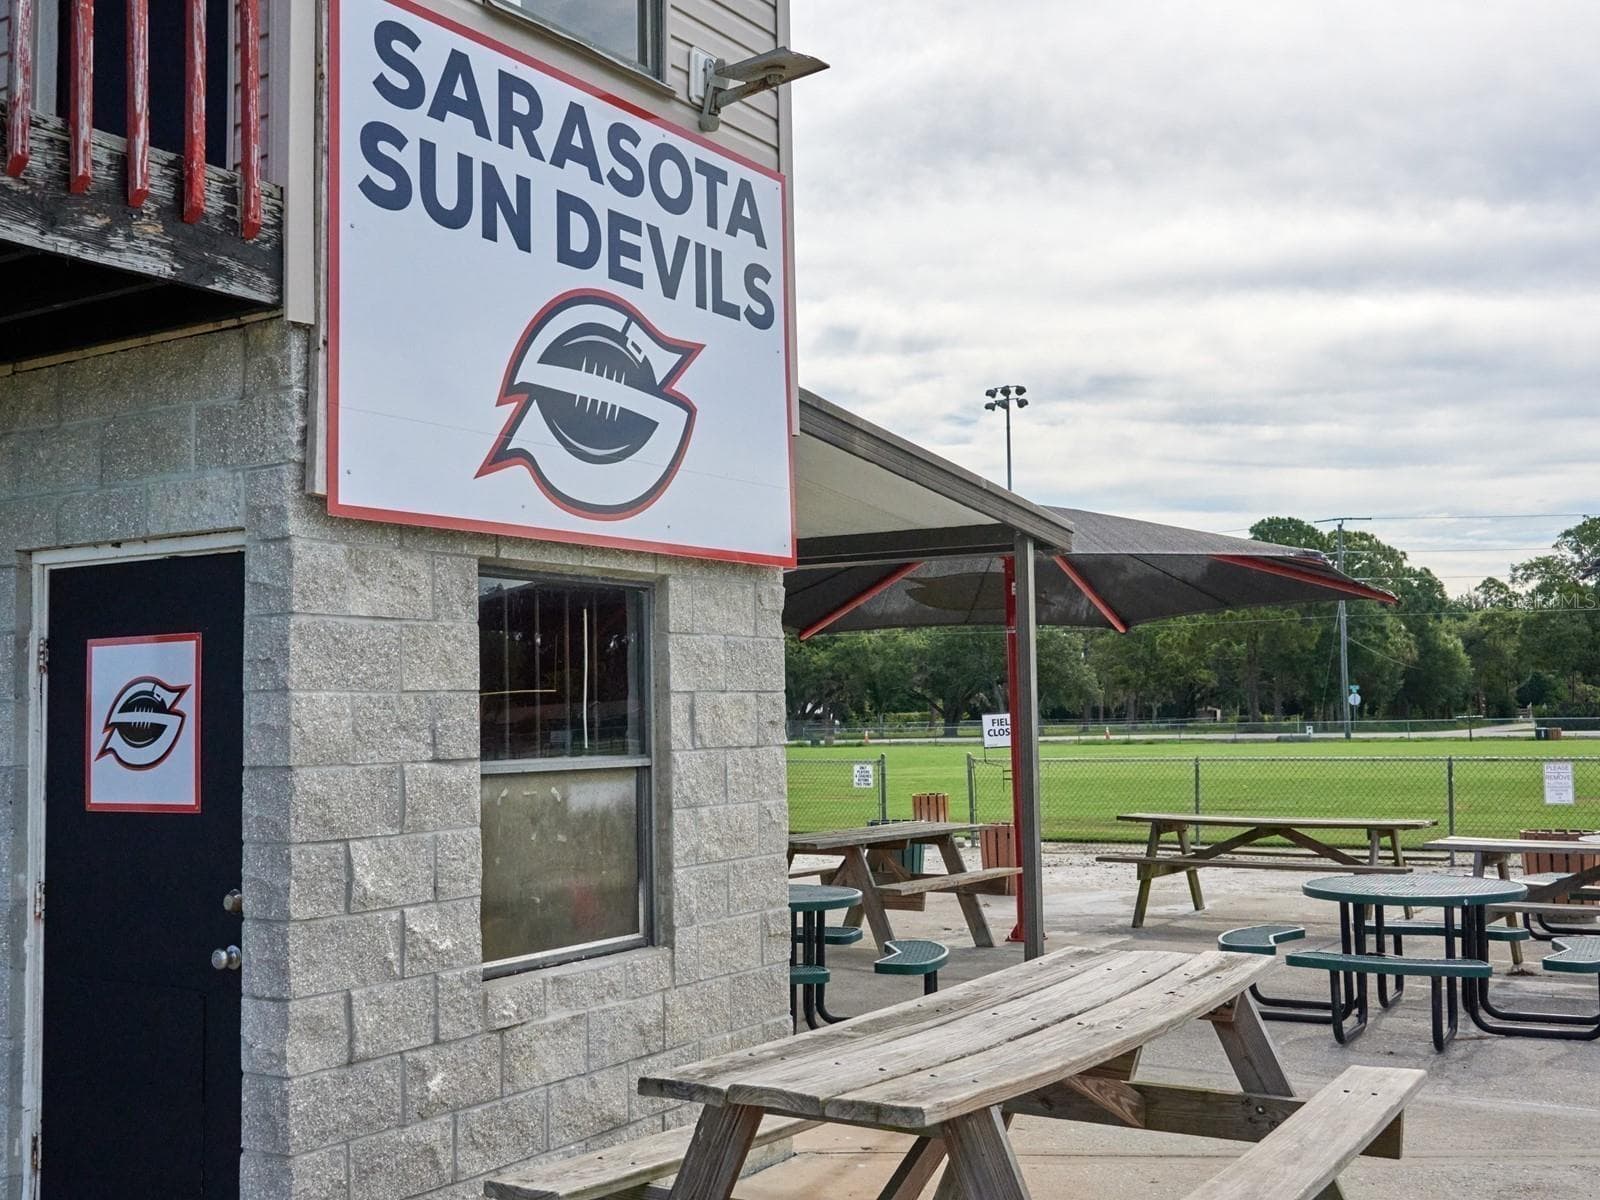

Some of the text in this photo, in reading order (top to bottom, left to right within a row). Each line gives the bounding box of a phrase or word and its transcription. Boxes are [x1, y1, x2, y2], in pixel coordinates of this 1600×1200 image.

[372, 20, 767, 250] SARASOTA
[357, 120, 775, 331] SUN DEVILS
[987, 728, 1011, 737] CLOS
[991, 718, 1011, 727] FIEL
